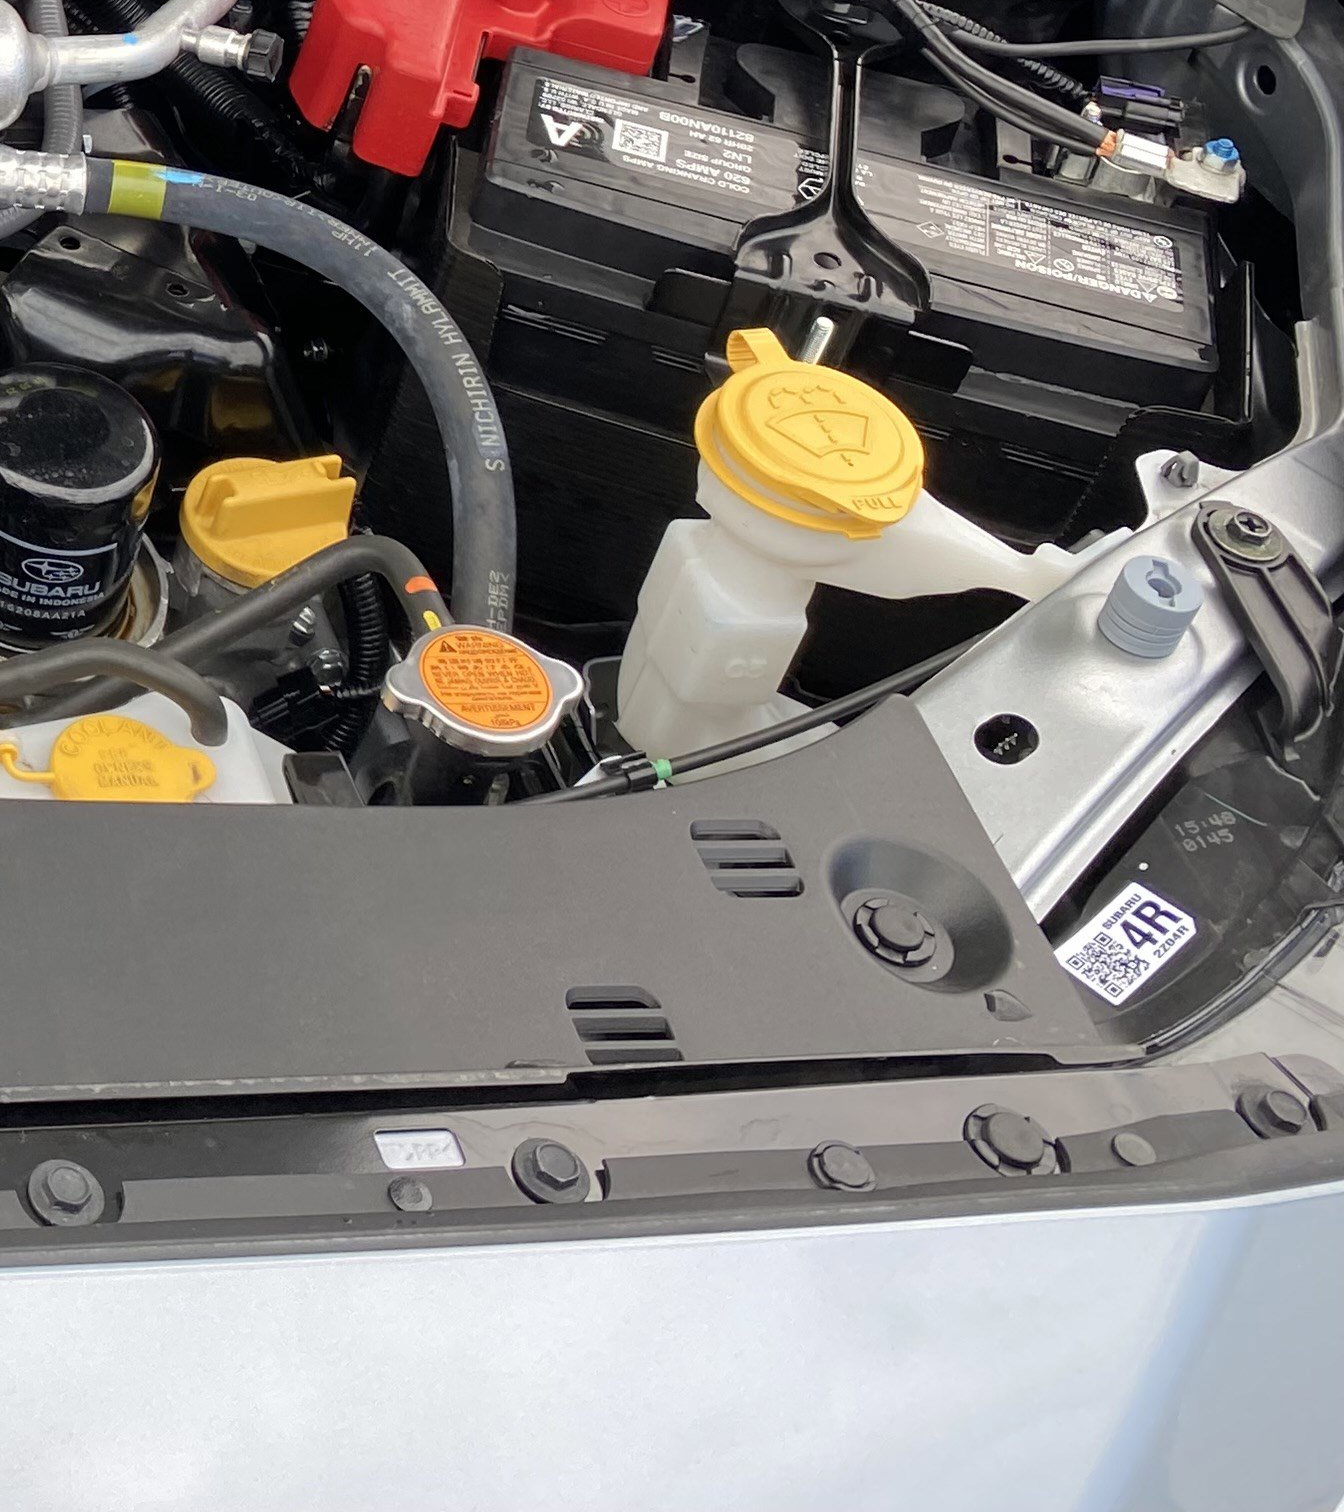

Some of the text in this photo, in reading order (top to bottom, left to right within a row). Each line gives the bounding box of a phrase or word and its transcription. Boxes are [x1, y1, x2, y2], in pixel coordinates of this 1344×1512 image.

[688, 129, 706, 139] AH
[621, 154, 750, 193] COLD CRANKING AMPS
[674, 158, 751, 185] 620 AMPS
[683, 149, 752, 173] GROUP SIZE
[721, 148, 753, 163] LN2
[1015, 260, 1149, 301] DANGER/POISON
[387, 269, 462, 345] HYLAMMIT
[452, 353, 500, 448] NICHIRIN
[21, 594, 36, 603] IN
[39, 592, 105, 607] INDONESIA
[1102, 893, 1142, 929] SUBARU
[1120, 900, 1183, 949] 4R
